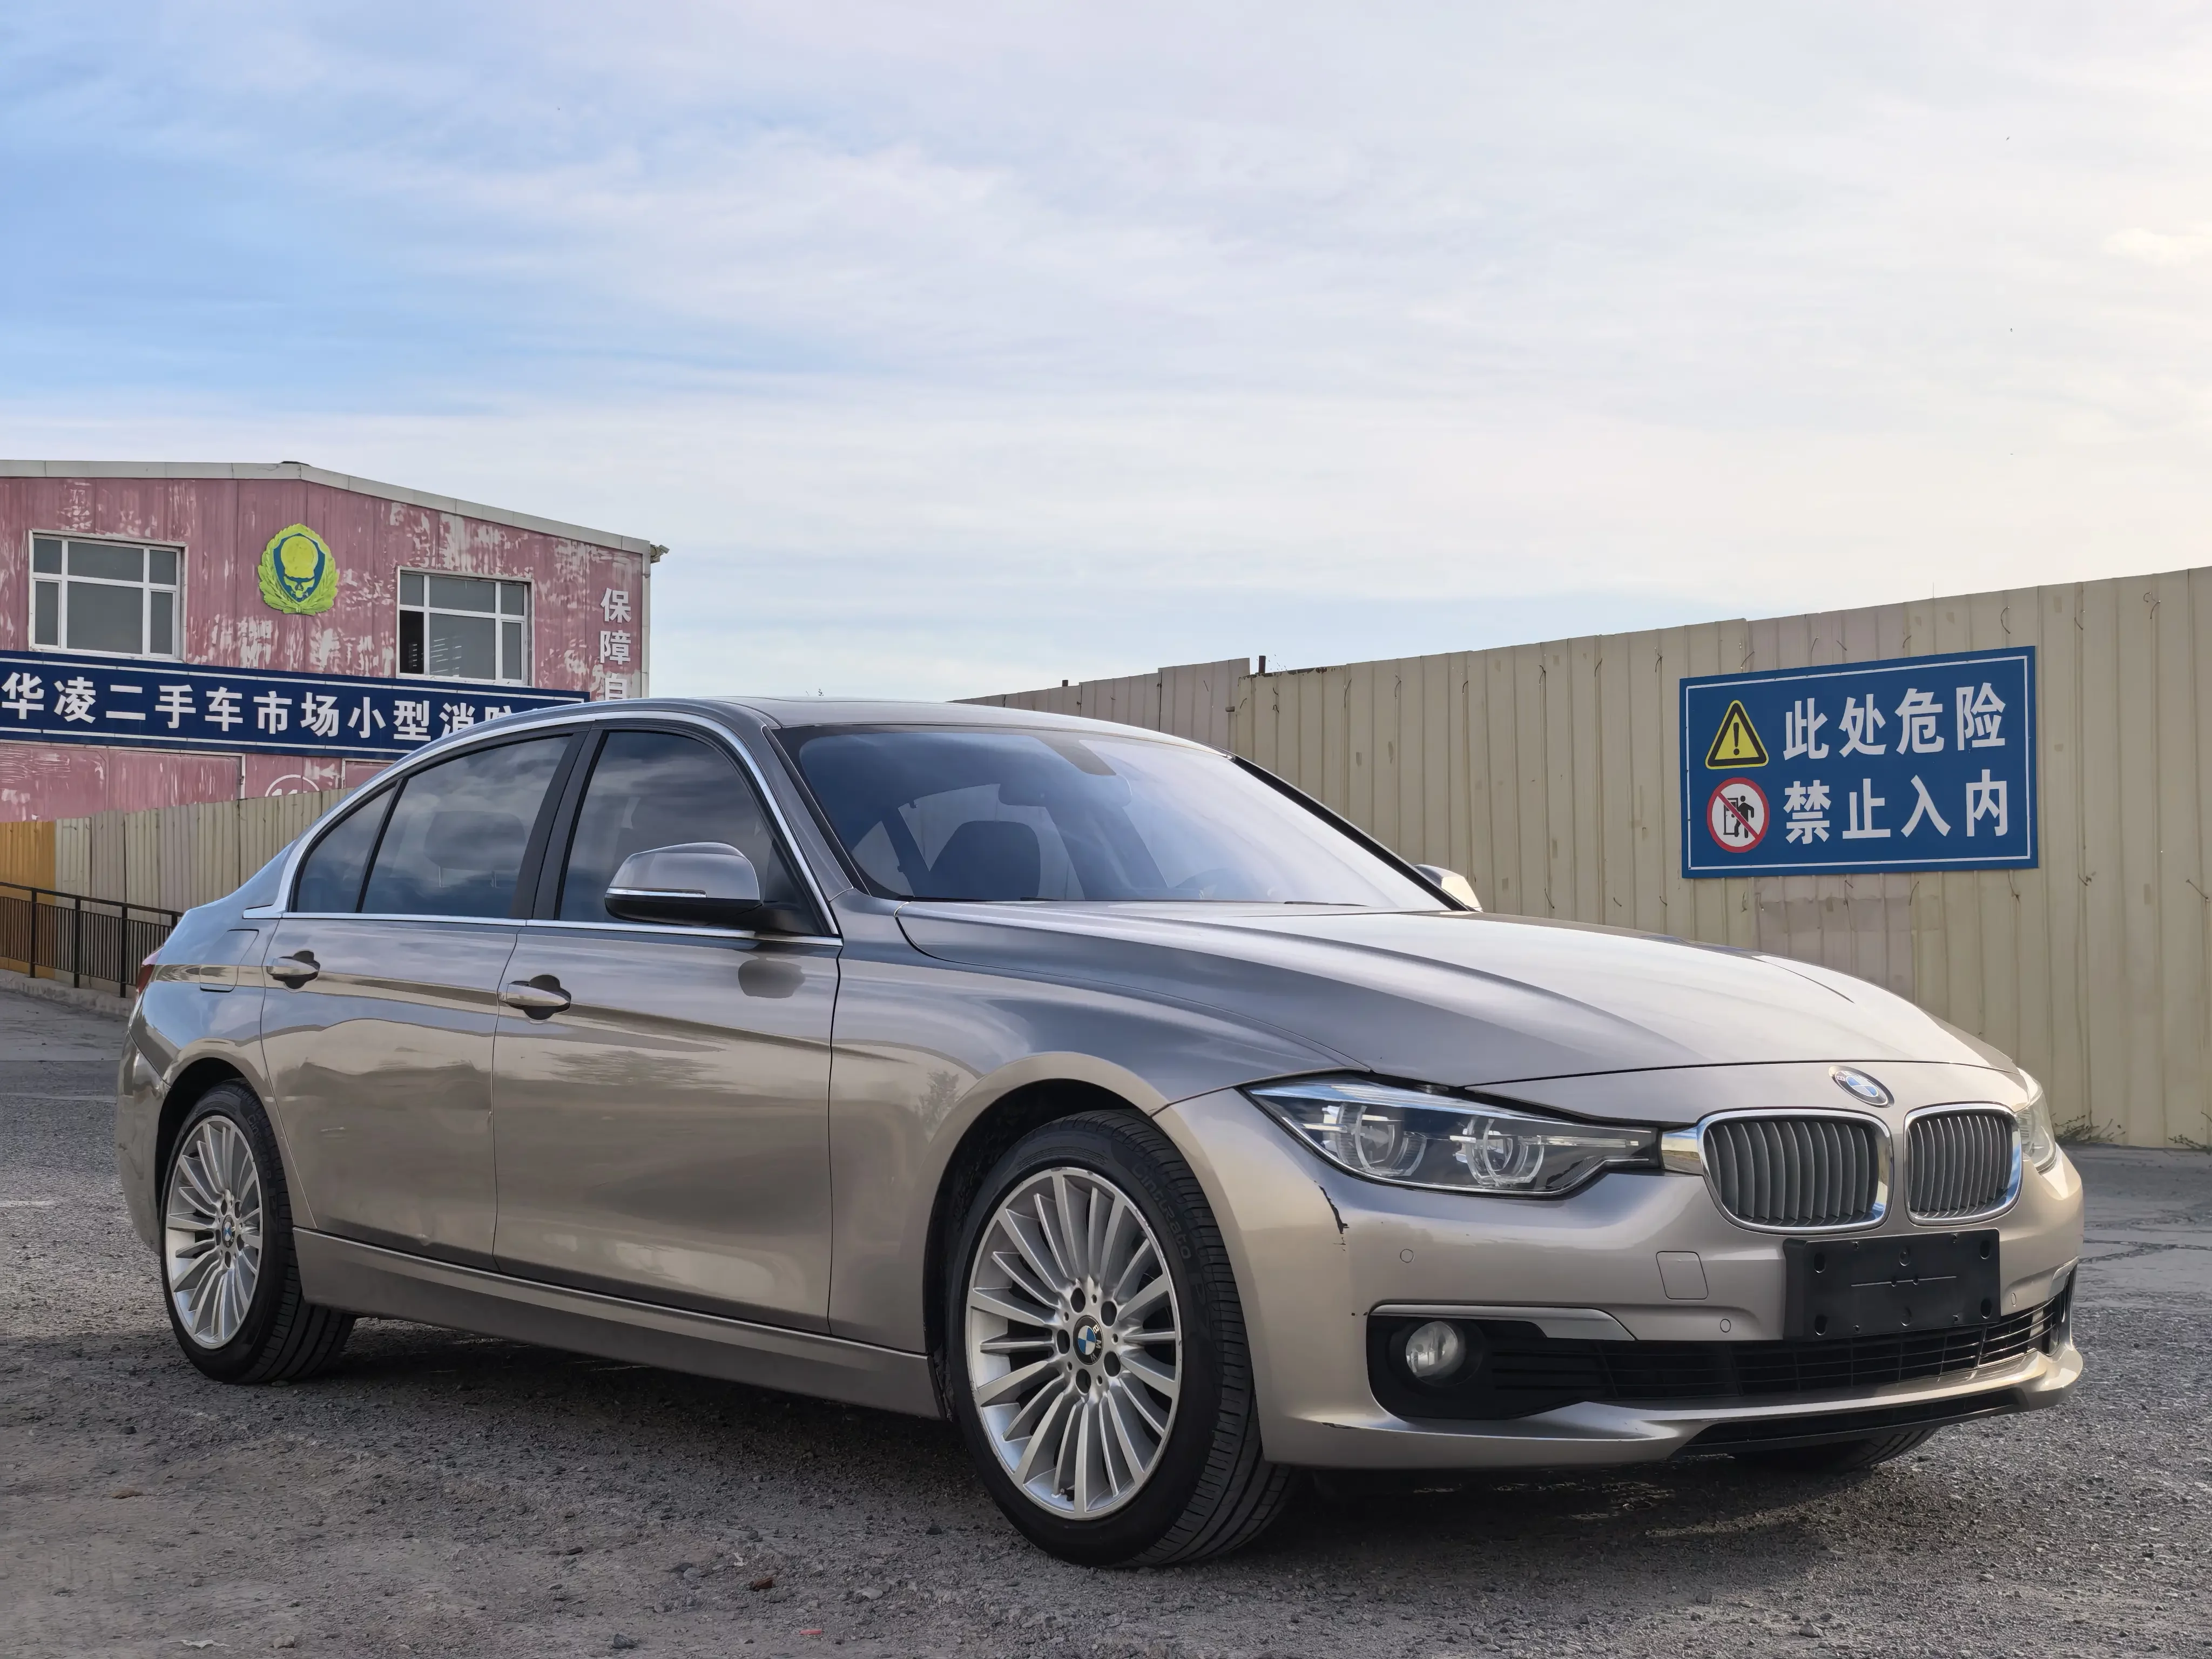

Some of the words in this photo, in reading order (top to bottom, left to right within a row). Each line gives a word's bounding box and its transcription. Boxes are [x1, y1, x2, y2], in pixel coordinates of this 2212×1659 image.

[1783, 682, 2006, 760] 此处危险
[1783, 769, 2008, 845] 禁止入内
[1090, 1324, 1102, 1362] BMW
